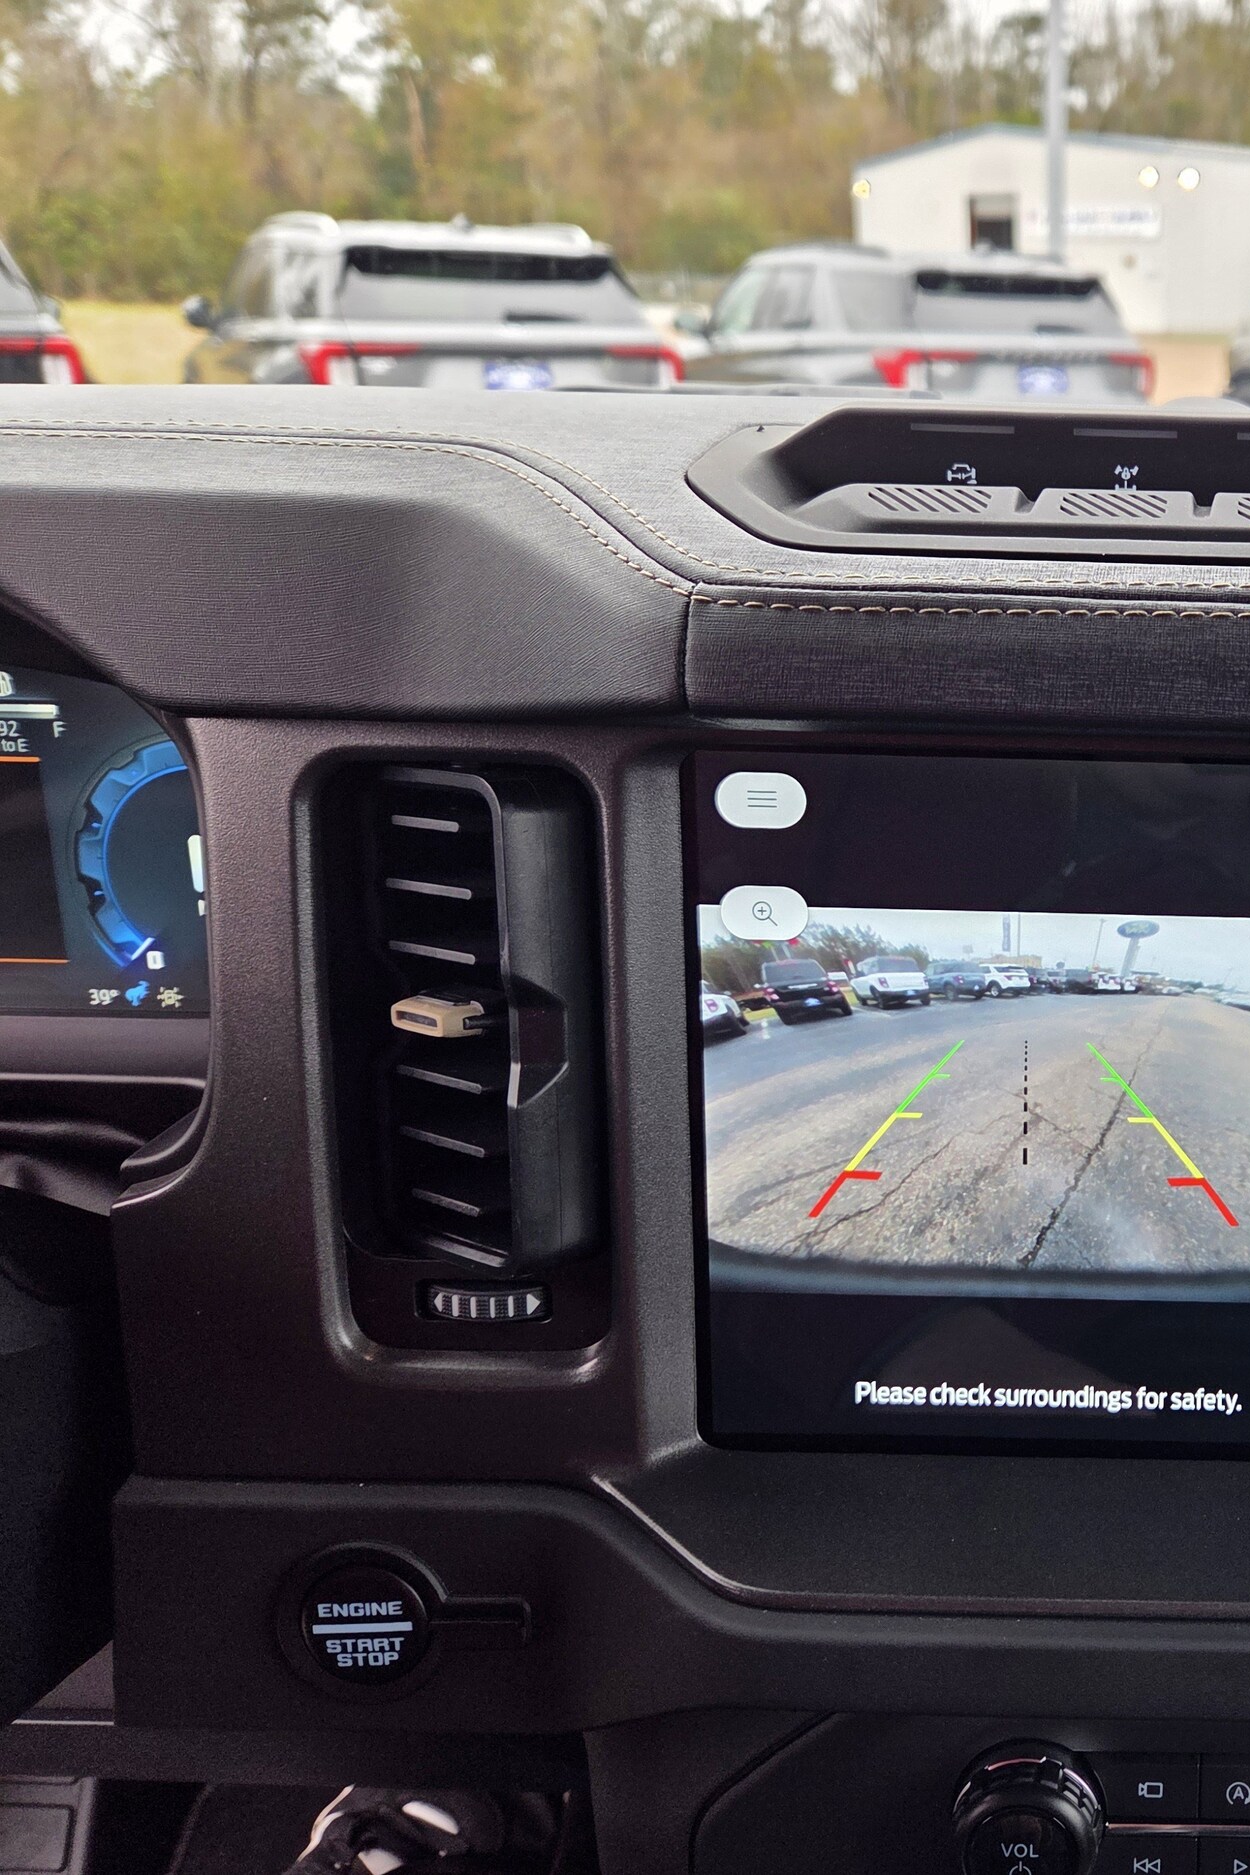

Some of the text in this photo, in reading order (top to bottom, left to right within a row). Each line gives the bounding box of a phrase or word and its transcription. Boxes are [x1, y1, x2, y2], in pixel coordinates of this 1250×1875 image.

[52, 721, 67, 738] F
[854, 1380, 1243, 1416] Please check surroundings for safety.
[317, 1601, 403, 1618] ENGINE
[325, 1637, 405, 1654] START
[336, 1651, 399, 1667] STOP
[1001, 1843, 1039, 1858] VOL
